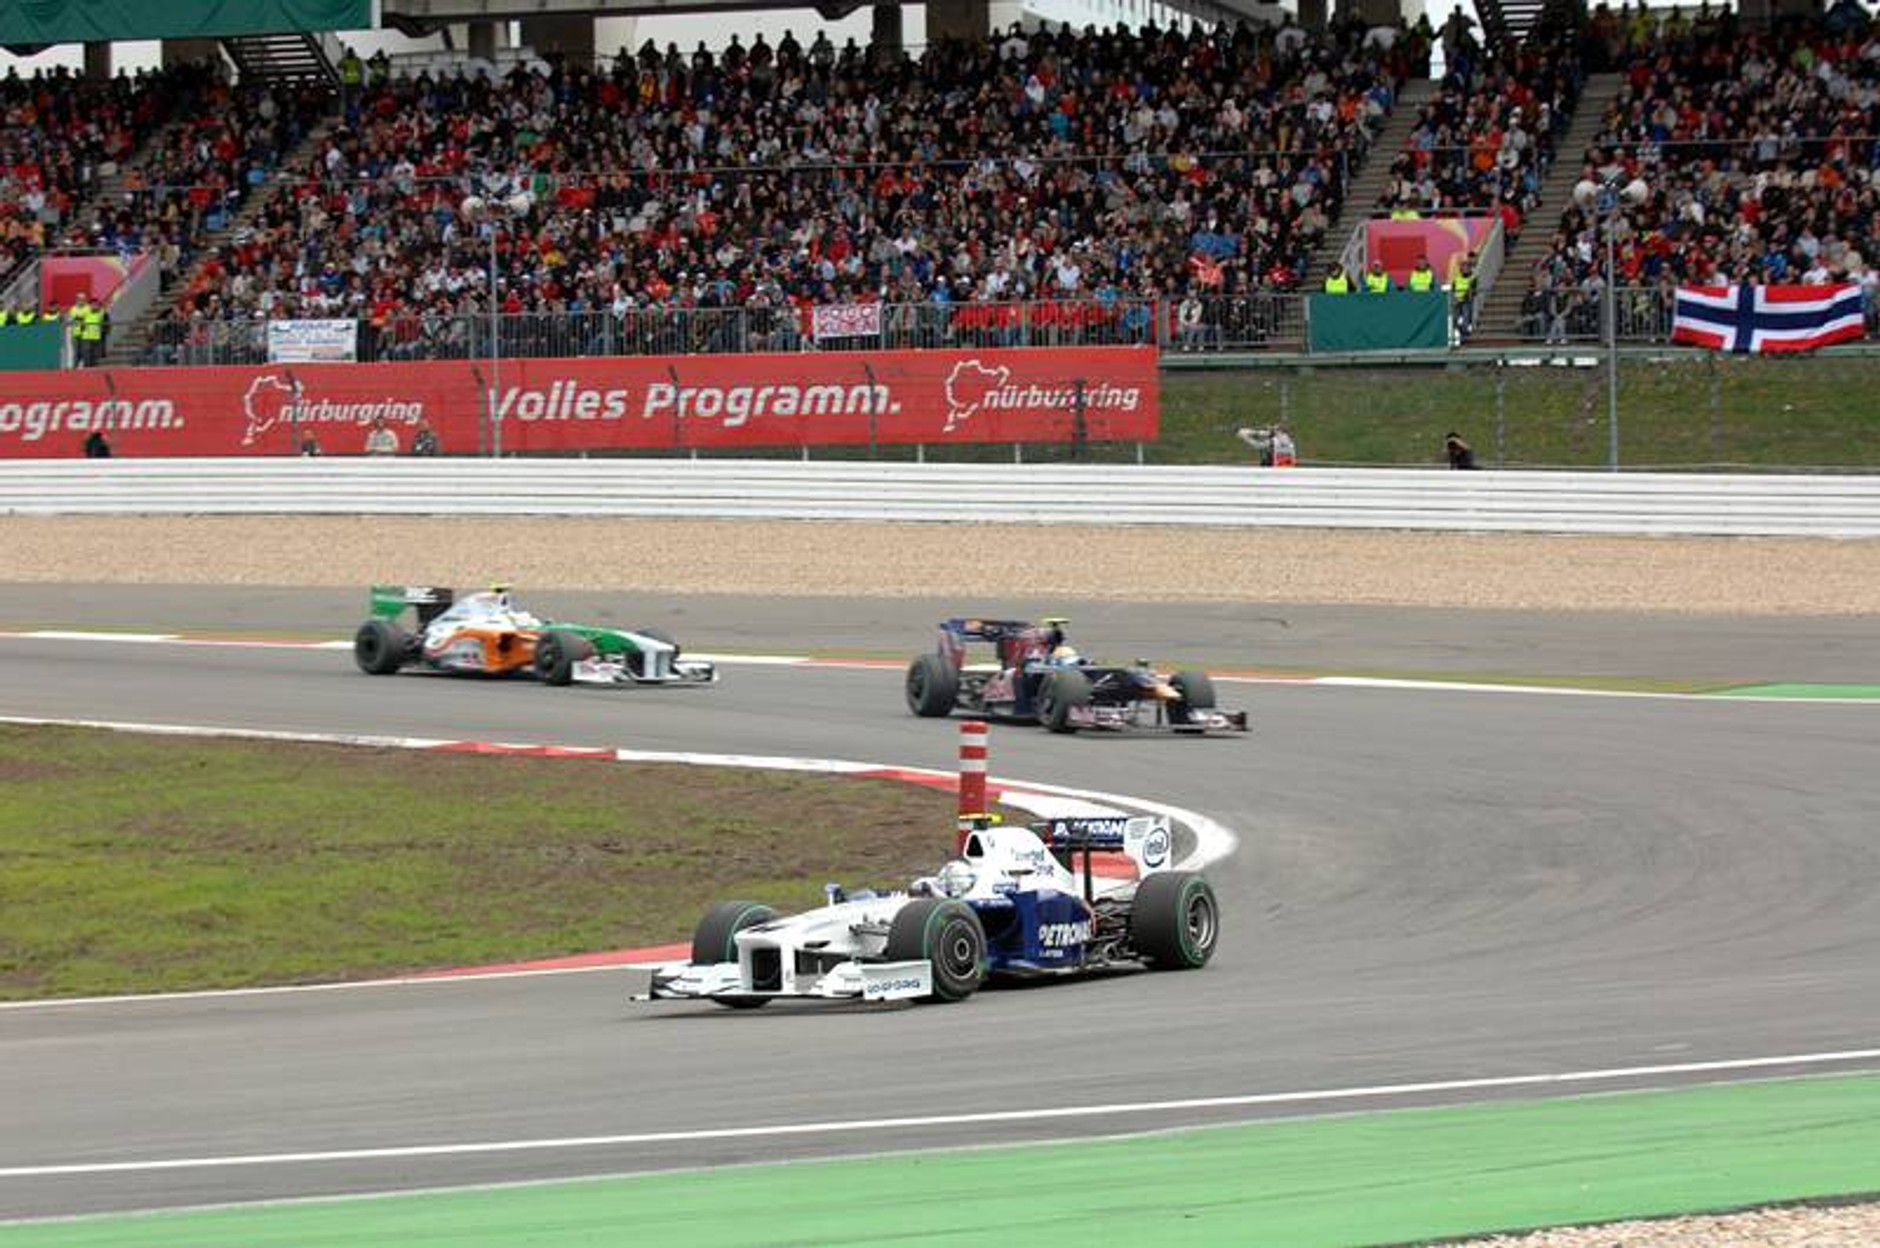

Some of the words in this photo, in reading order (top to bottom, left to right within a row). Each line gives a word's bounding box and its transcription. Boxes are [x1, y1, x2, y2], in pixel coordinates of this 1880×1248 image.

[278, 397, 423, 426] nürburgring
[488, 380, 629, 421] Volles
[642, 382, 902, 427] Programm.
